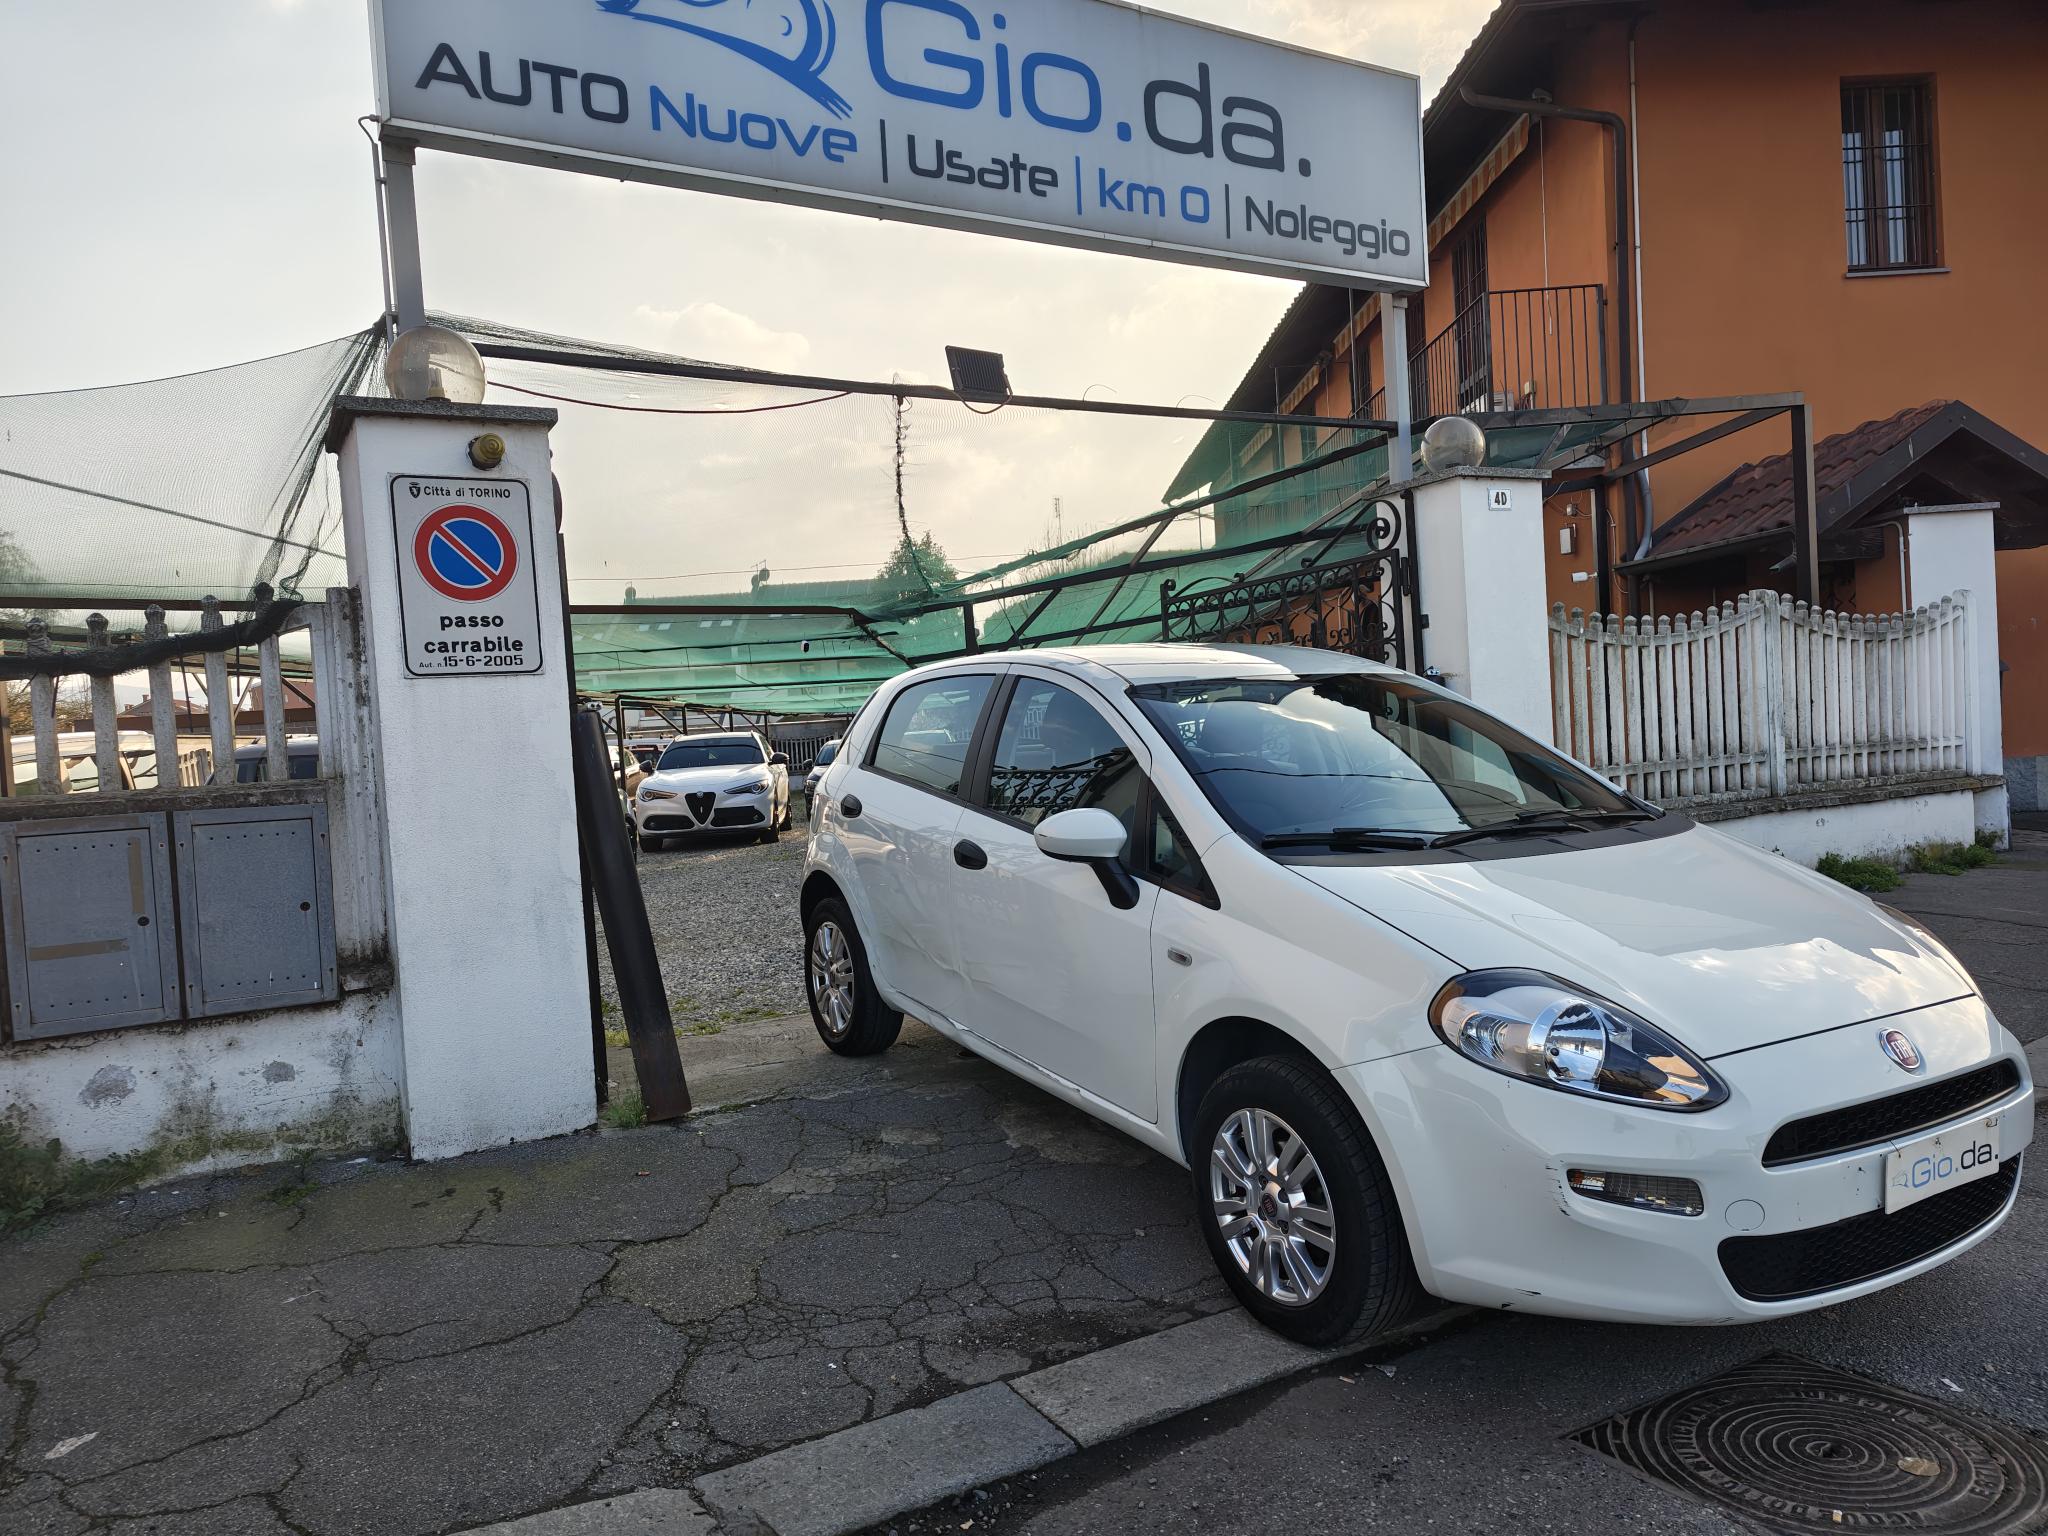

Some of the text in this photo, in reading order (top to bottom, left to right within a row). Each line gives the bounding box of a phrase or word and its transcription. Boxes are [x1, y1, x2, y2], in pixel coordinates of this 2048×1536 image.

[866, 0, 1312, 178] Gio.da.
[415, 42, 629, 125] AUTO
[649, 85, 858, 164] Nuove
[908, 134, 1058, 198] Usate
[1099, 167, 1166, 218] km
[1245, 196, 1410, 259] Noleggio
[423, 486, 511, 499] Città di TORINO
[440, 615, 504, 631] passo
[424, 636, 524, 654] carrabile
[443, 655, 524, 667] 15-6-2005
[1911, 1140, 1999, 1188] Gio.da.
